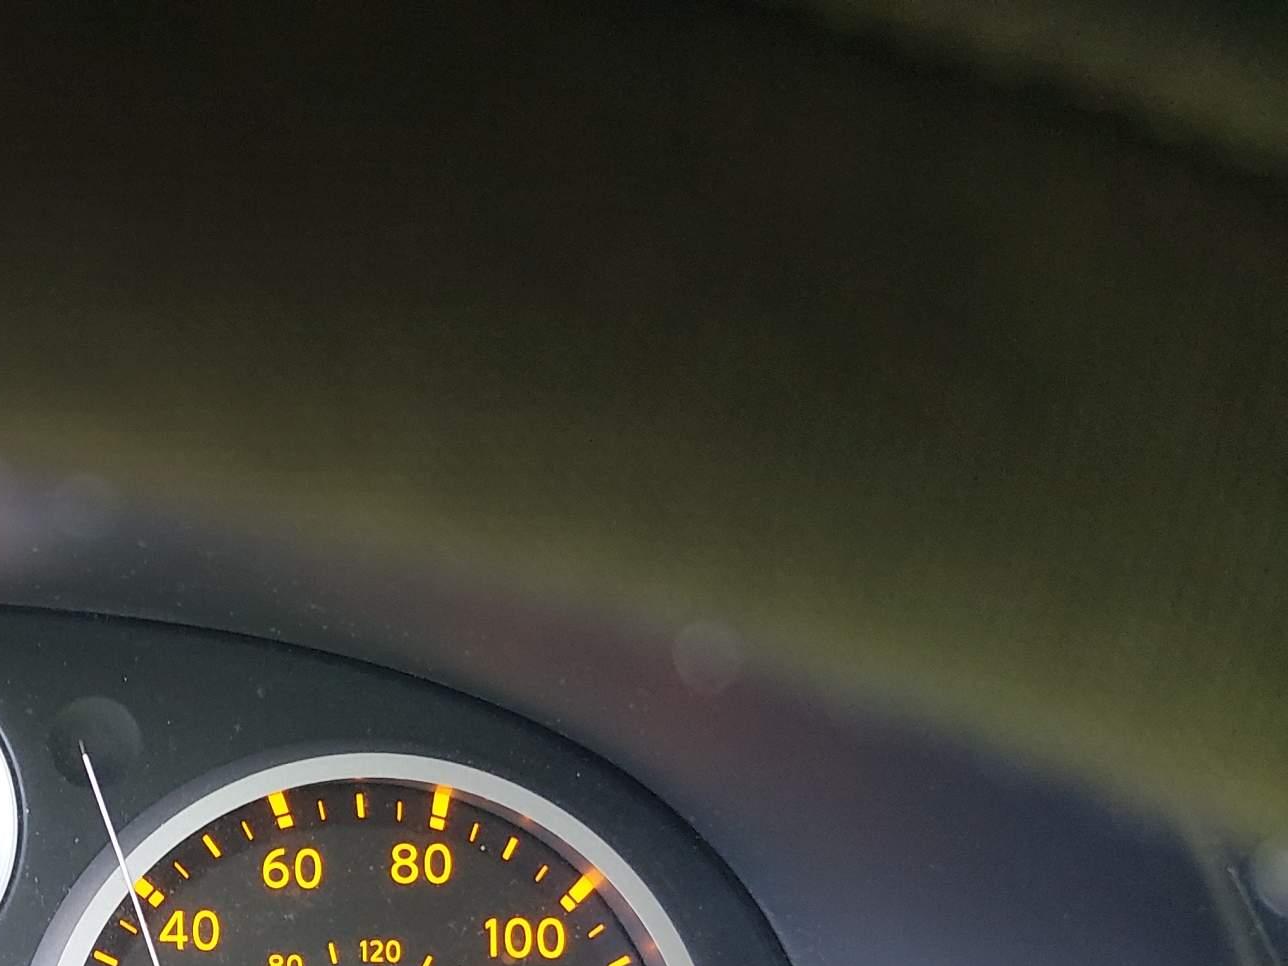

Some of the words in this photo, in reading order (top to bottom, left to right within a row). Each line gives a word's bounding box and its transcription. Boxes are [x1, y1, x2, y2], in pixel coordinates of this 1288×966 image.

[262, 848, 322, 890] 60
[390, 843, 452, 885] 80
[159, 910, 220, 951] 40
[485, 917, 565, 959] 100
[359, 941, 401, 964] 120
